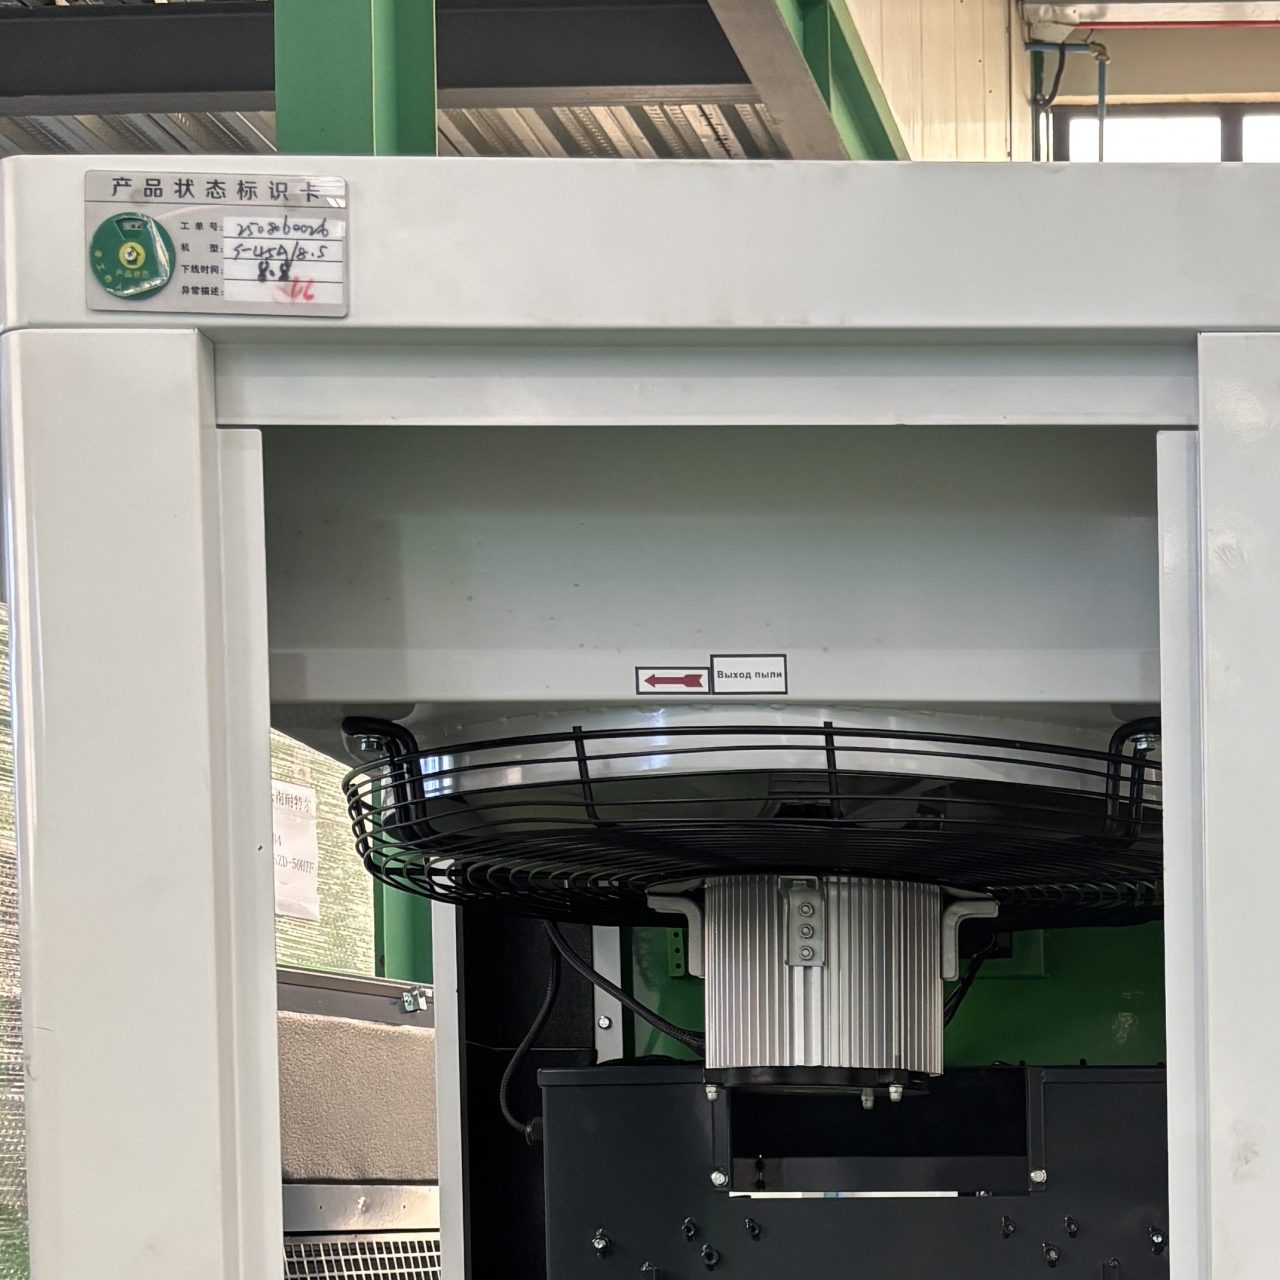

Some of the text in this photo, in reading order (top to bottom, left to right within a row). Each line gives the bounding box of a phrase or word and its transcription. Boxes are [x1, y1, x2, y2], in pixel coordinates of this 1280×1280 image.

[112, 177, 321, 203] 产品状态标识卡
[717, 670, 751, 680] Выход
